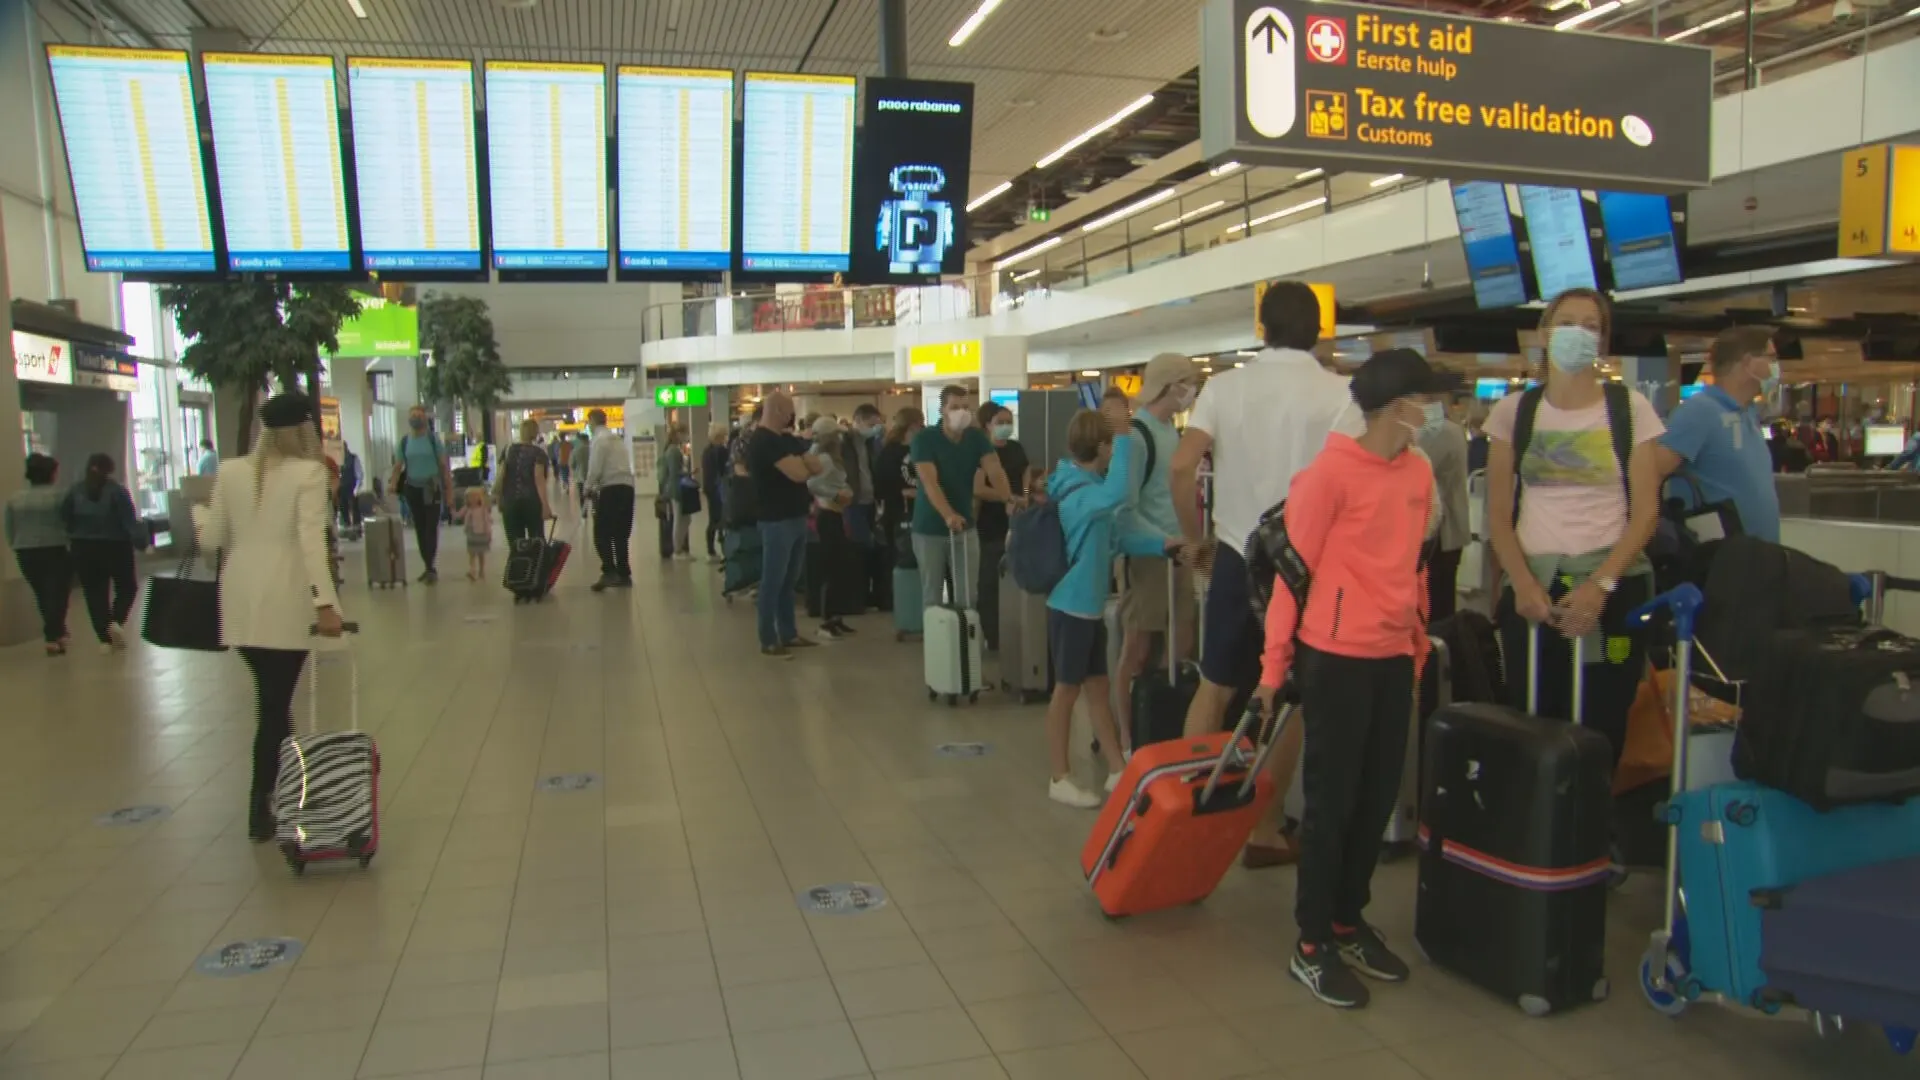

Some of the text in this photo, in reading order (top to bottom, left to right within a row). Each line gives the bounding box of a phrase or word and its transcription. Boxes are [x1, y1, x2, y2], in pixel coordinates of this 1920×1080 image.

[1356, 14, 1473, 54] First aid
[1356, 49, 1457, 81] Eerste hulp
[1355, 87, 1405, 119] Tax
[1414, 91, 1472, 125] free
[1480, 101, 1614, 139] validation
[1357, 122, 1434, 147] Customs
[1856, 157, 1868, 178] 5
